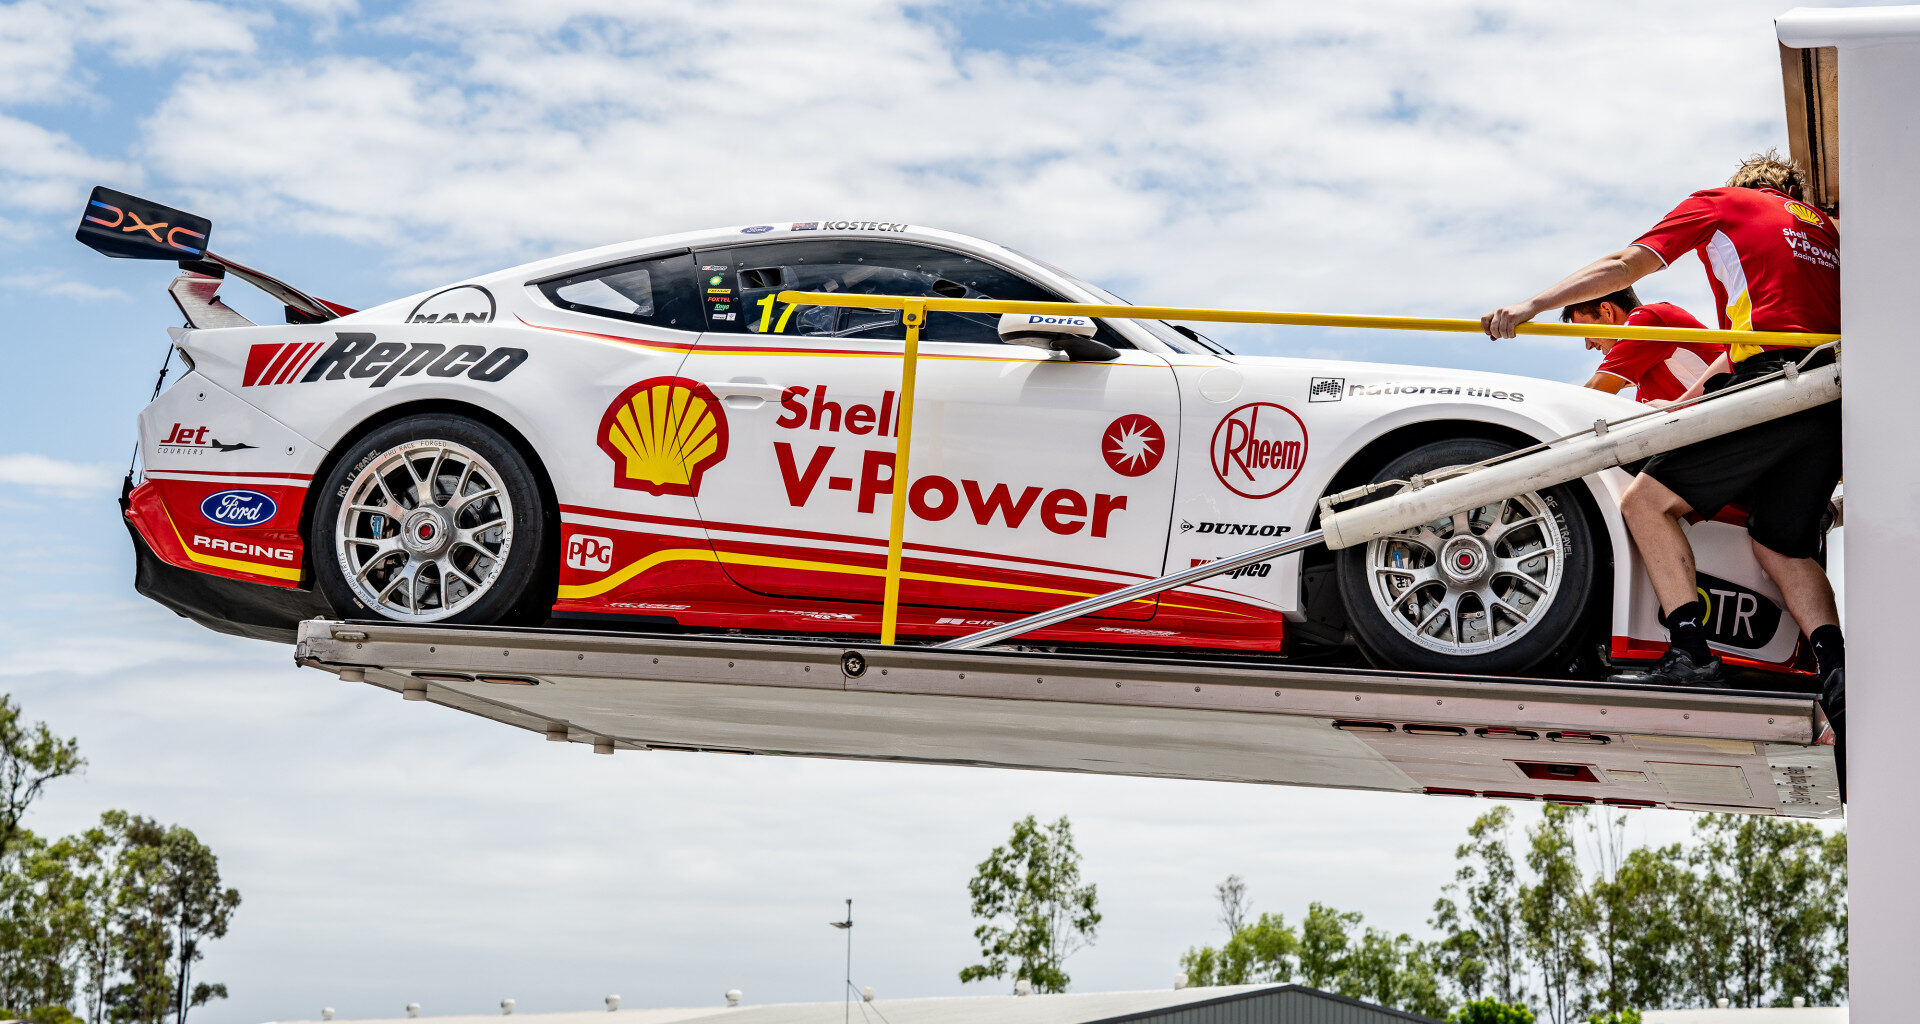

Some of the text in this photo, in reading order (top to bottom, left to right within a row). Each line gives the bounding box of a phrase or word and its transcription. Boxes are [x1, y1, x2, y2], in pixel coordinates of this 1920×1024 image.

[85, 200, 205, 255] DXC
[823, 221, 908, 232] KOSTECKI
[1782, 228, 1808, 240] Shell
[1793, 250, 1834, 269] Racing Team
[412, 312, 489, 324] MAN
[756, 294, 798, 333] 17
[1028, 315, 1085, 326] Doric
[300, 332, 529, 389] Repco
[1348, 382, 1525, 402] national tiles
[160, 422, 210, 445] Jet
[1222, 406, 1301, 481] Rheem
[157, 447, 204, 456] COURIERS
[337, 450, 381, 498] RR 17 TRAVEL
[773, 441, 1128, 539] V-Power
[215, 494, 263, 521] Ford
[1196, 522, 1291, 537] DUNLOP
[1554, 513, 1566, 523] 17
[1560, 525, 1573, 558] TRAVEL
[193, 534, 294, 561] RACING
[569, 538, 611, 567] PPG
[1697, 586, 1758, 639] TR
